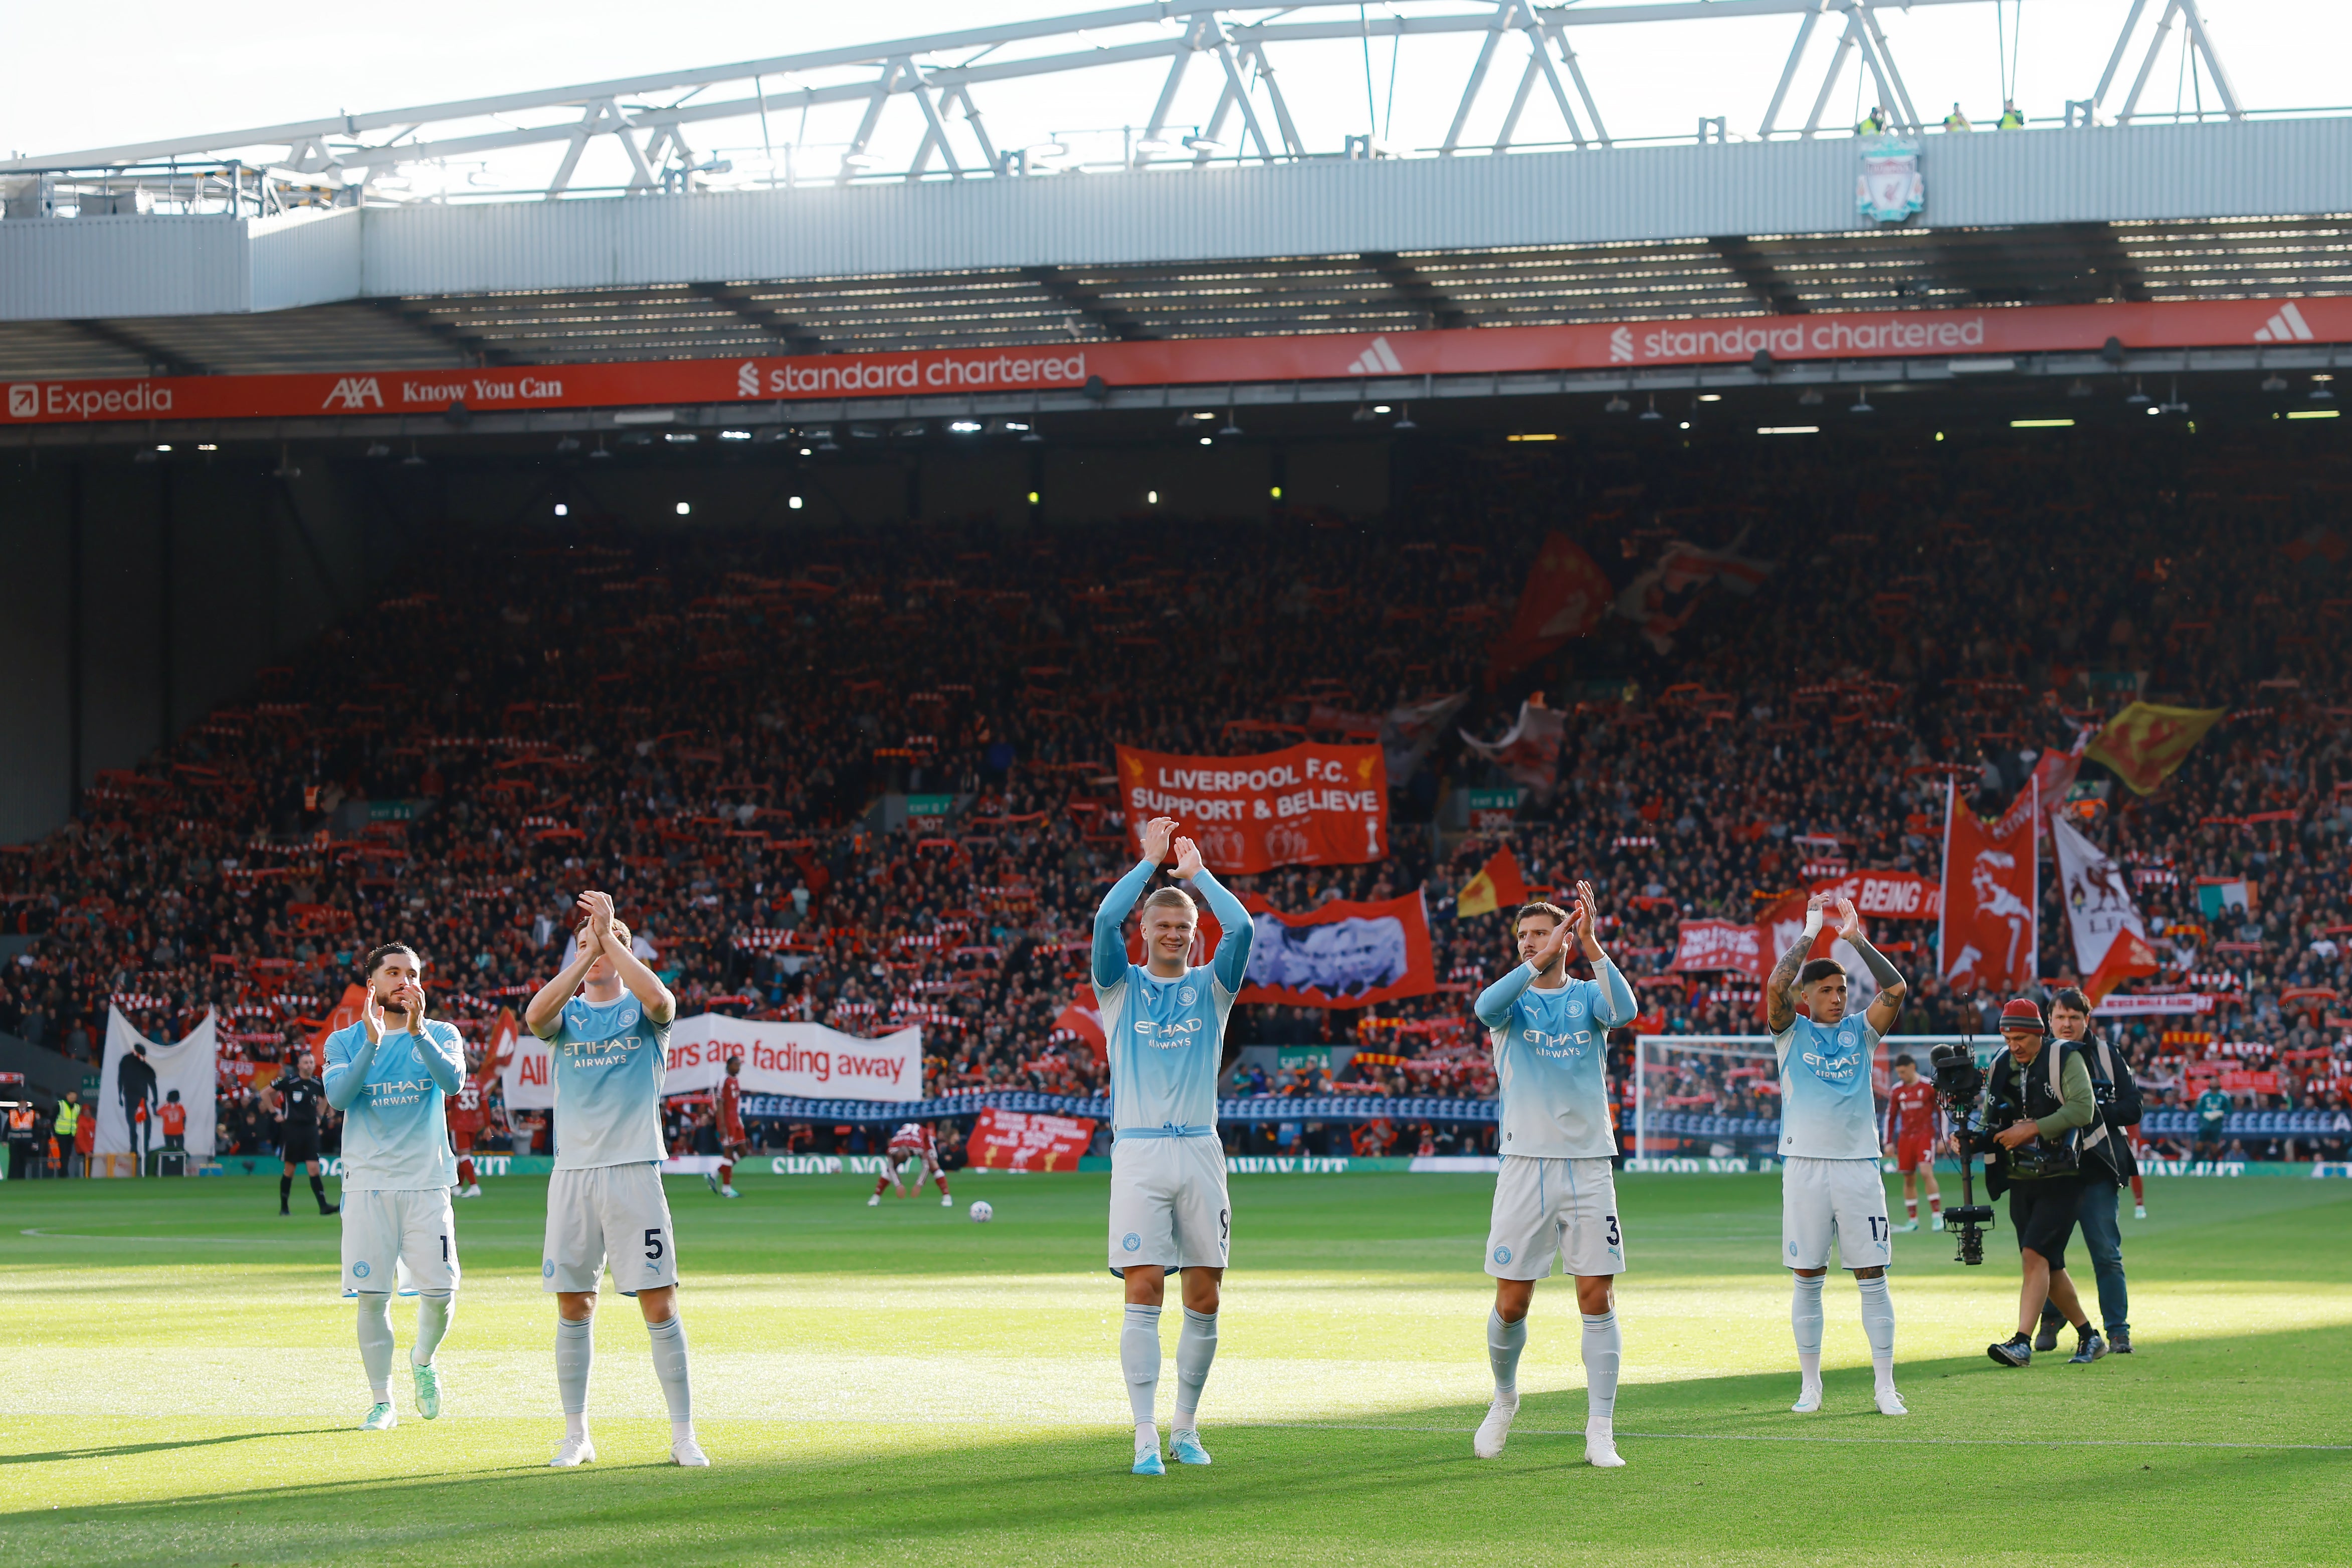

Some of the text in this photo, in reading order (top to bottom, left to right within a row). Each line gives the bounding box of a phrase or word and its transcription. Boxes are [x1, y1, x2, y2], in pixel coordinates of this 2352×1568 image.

[1644, 318, 1984, 358] standard chartered
[770, 352, 1085, 393] standard chartered
[47, 383, 172, 419] Expedia
[321, 377, 384, 409] AXA
[402, 377, 563, 402] Know You Can
[1158, 757, 1349, 791] LIVERPOOL F.C.
[1131, 787, 1380, 821] SUPPORT & BELIEVE
[1859, 879, 1922, 913] BEING
[1134, 1018, 1202, 1039] ETIHAD
[1523, 1029, 1592, 1047] ETIHAD
[564, 1036, 642, 1056] ETIHAD
[1148, 1037, 1191, 1050] AIRWAYS
[1536, 1047, 1581, 1058] AIRWAYS
[518, 1039, 905, 1087] All ars are fading away
[574, 1054, 627, 1068] AIRWAYS
[1816, 1069, 1853, 1079] AIRWAYS
[371, 1095, 420, 1107] AIRWAYS
[457, 1090, 481, 1111] 33
[1220, 1209, 1228, 1239] 9
[1606, 1216, 1620, 1246] 3
[1868, 1216, 1888, 1241] 17
[645, 1228, 663, 1260] 5
